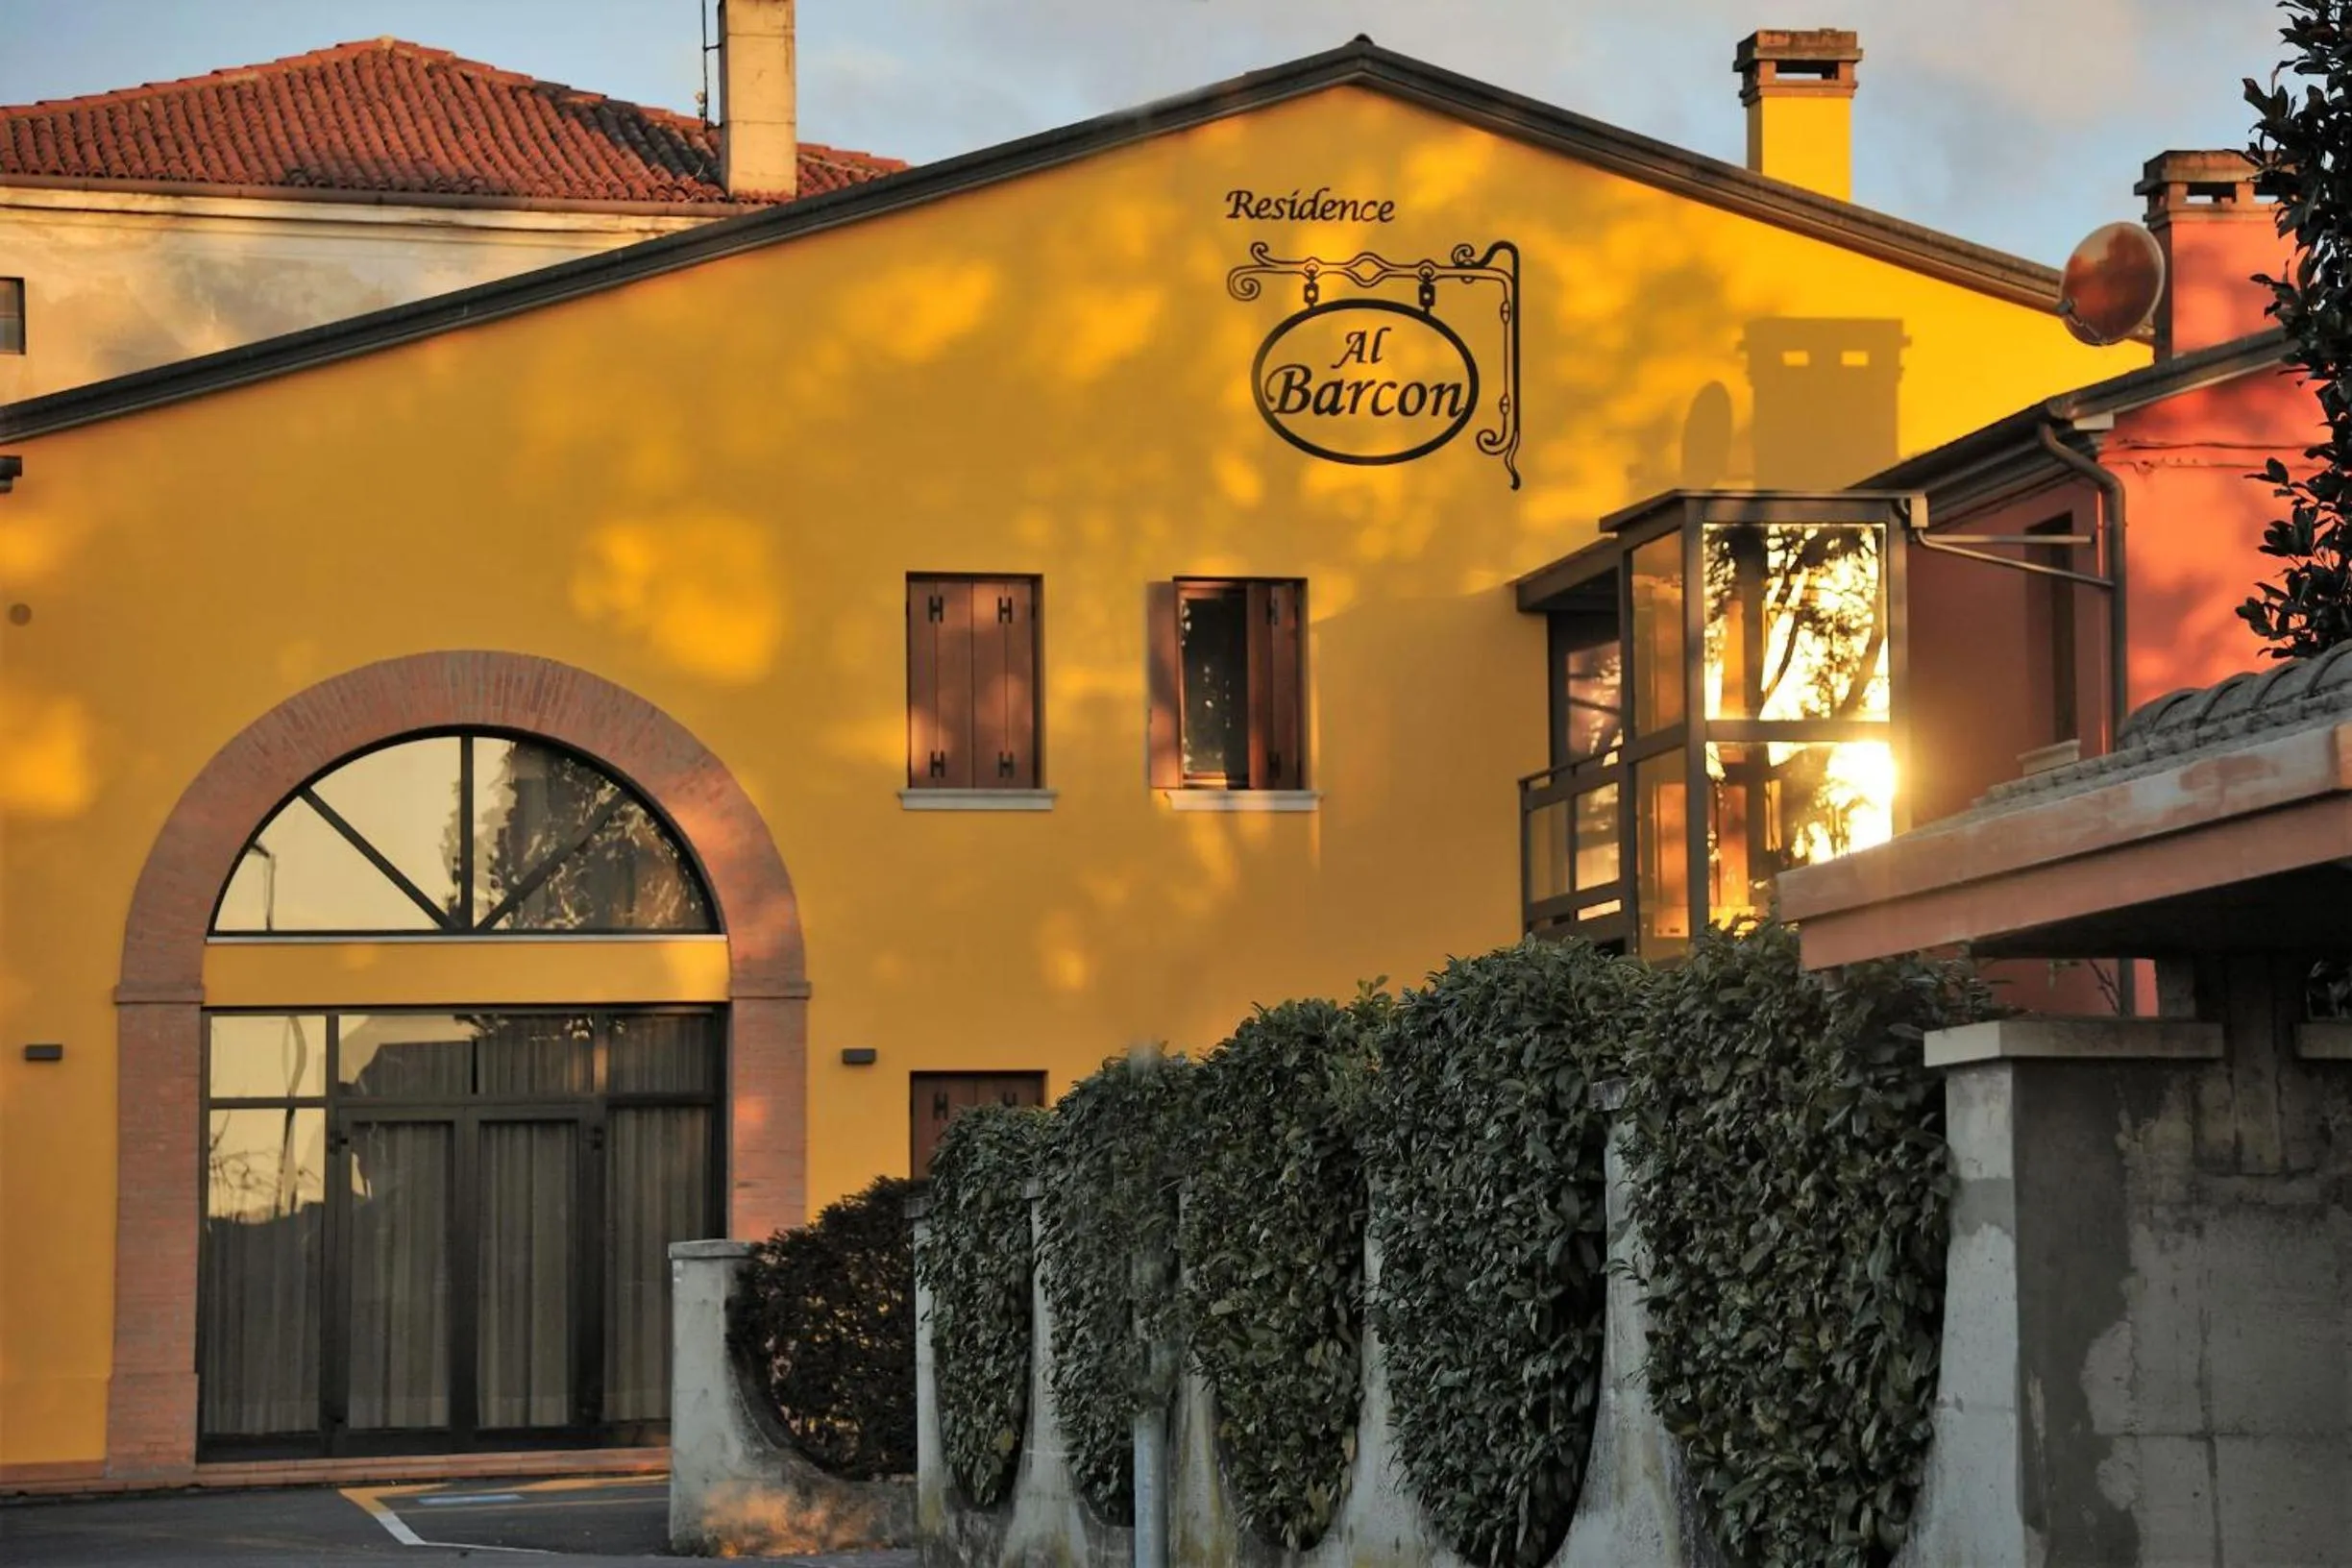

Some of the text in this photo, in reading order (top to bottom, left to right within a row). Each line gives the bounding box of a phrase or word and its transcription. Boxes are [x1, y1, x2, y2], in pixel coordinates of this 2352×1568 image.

[1225, 187, 1395, 223] Residence
[1331, 327, 1392, 369] Al
[1264, 364, 1465, 417] Barcon
